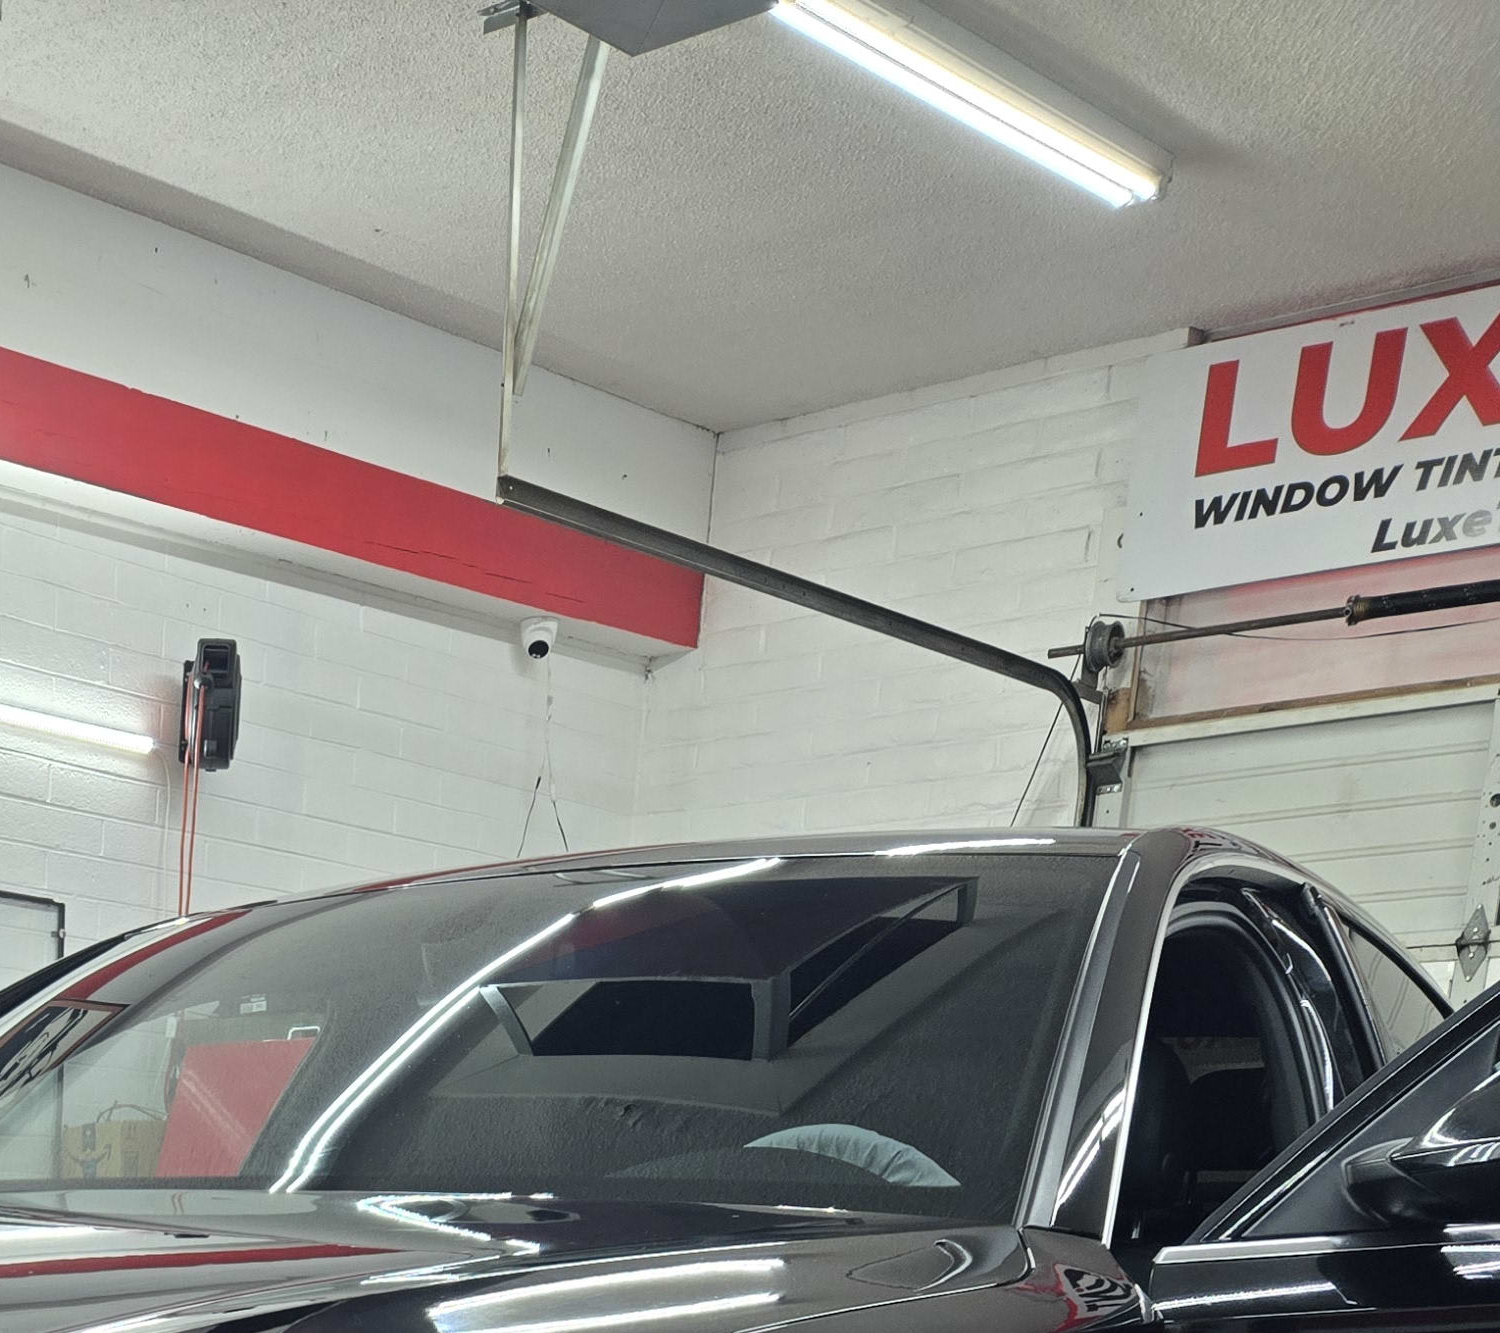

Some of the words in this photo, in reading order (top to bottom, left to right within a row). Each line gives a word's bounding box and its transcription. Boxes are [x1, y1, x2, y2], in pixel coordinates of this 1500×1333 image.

[1194, 315, 1500, 478] LUX
[1193, 464, 1404, 529] WINDOW
[1414, 447, 1500, 492] TIN
[1370, 500, 1500, 554] Luxe
